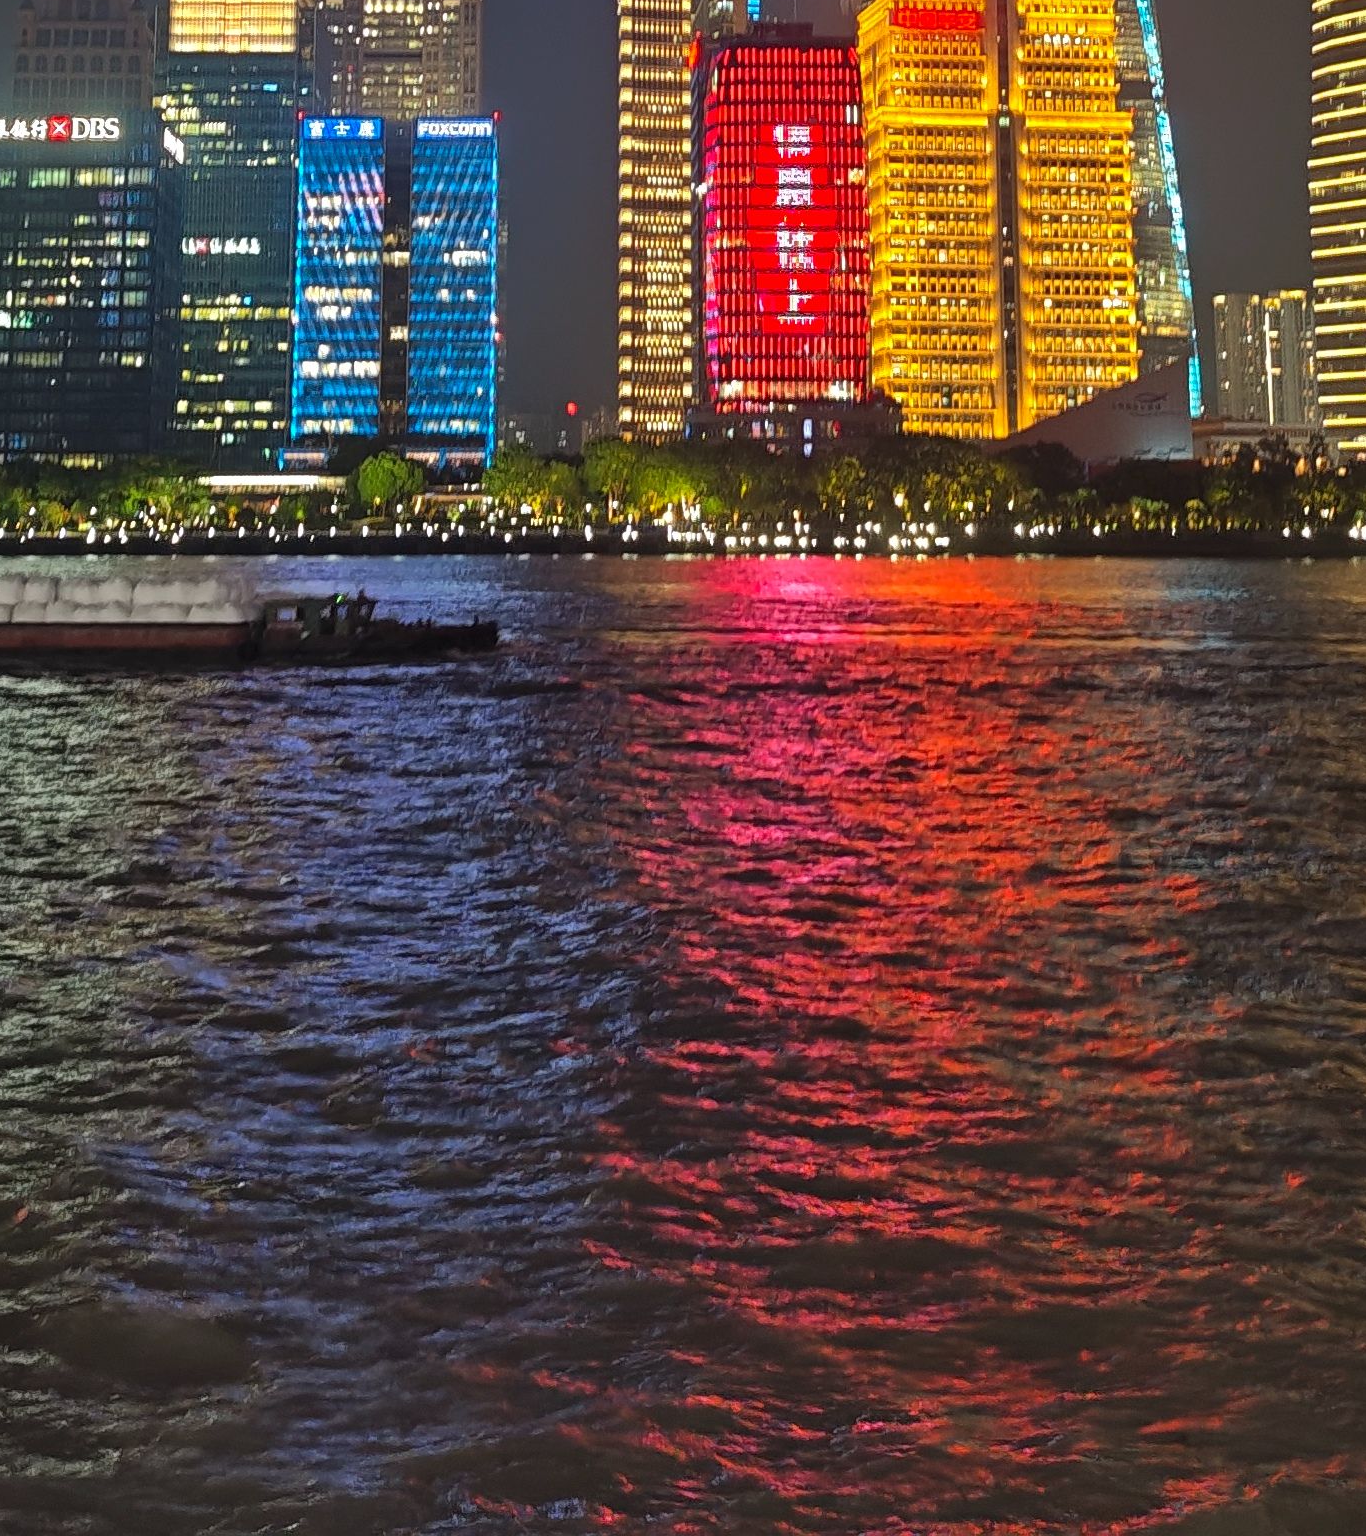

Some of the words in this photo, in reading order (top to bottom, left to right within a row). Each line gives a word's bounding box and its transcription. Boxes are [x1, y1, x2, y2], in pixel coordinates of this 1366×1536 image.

[71, 117, 120, 140] DBS
[308, 119, 376, 137] 富士康
